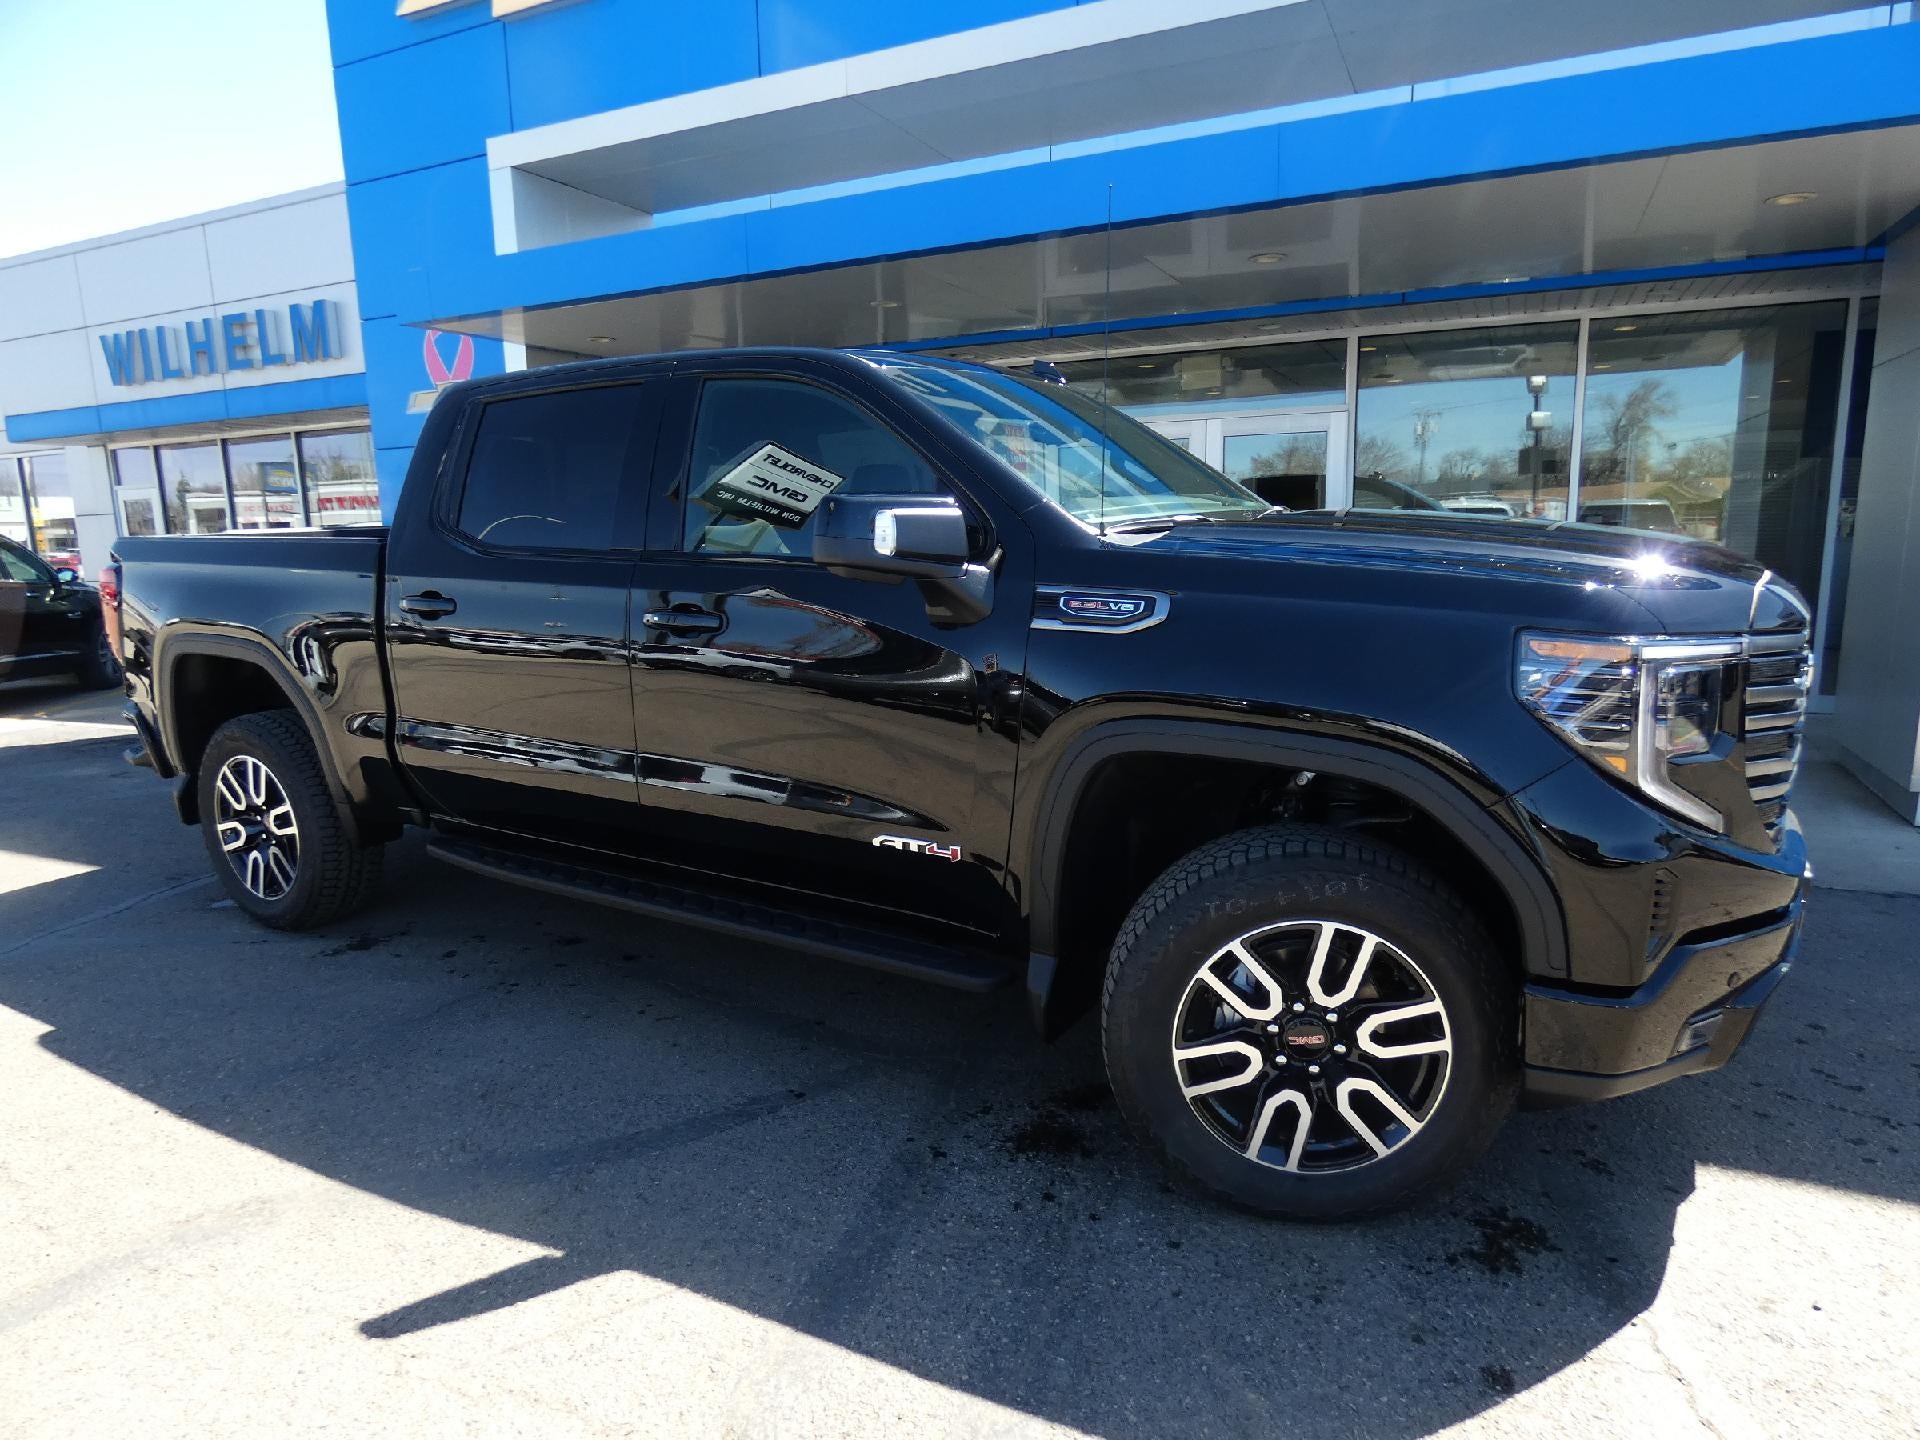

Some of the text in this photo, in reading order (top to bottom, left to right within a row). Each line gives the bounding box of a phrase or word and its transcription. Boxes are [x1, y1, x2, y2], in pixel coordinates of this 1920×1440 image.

[99, 299, 340, 387] WILHELM
[873, 835, 961, 862] AT4
[1288, 1034, 1325, 1045] GMC
